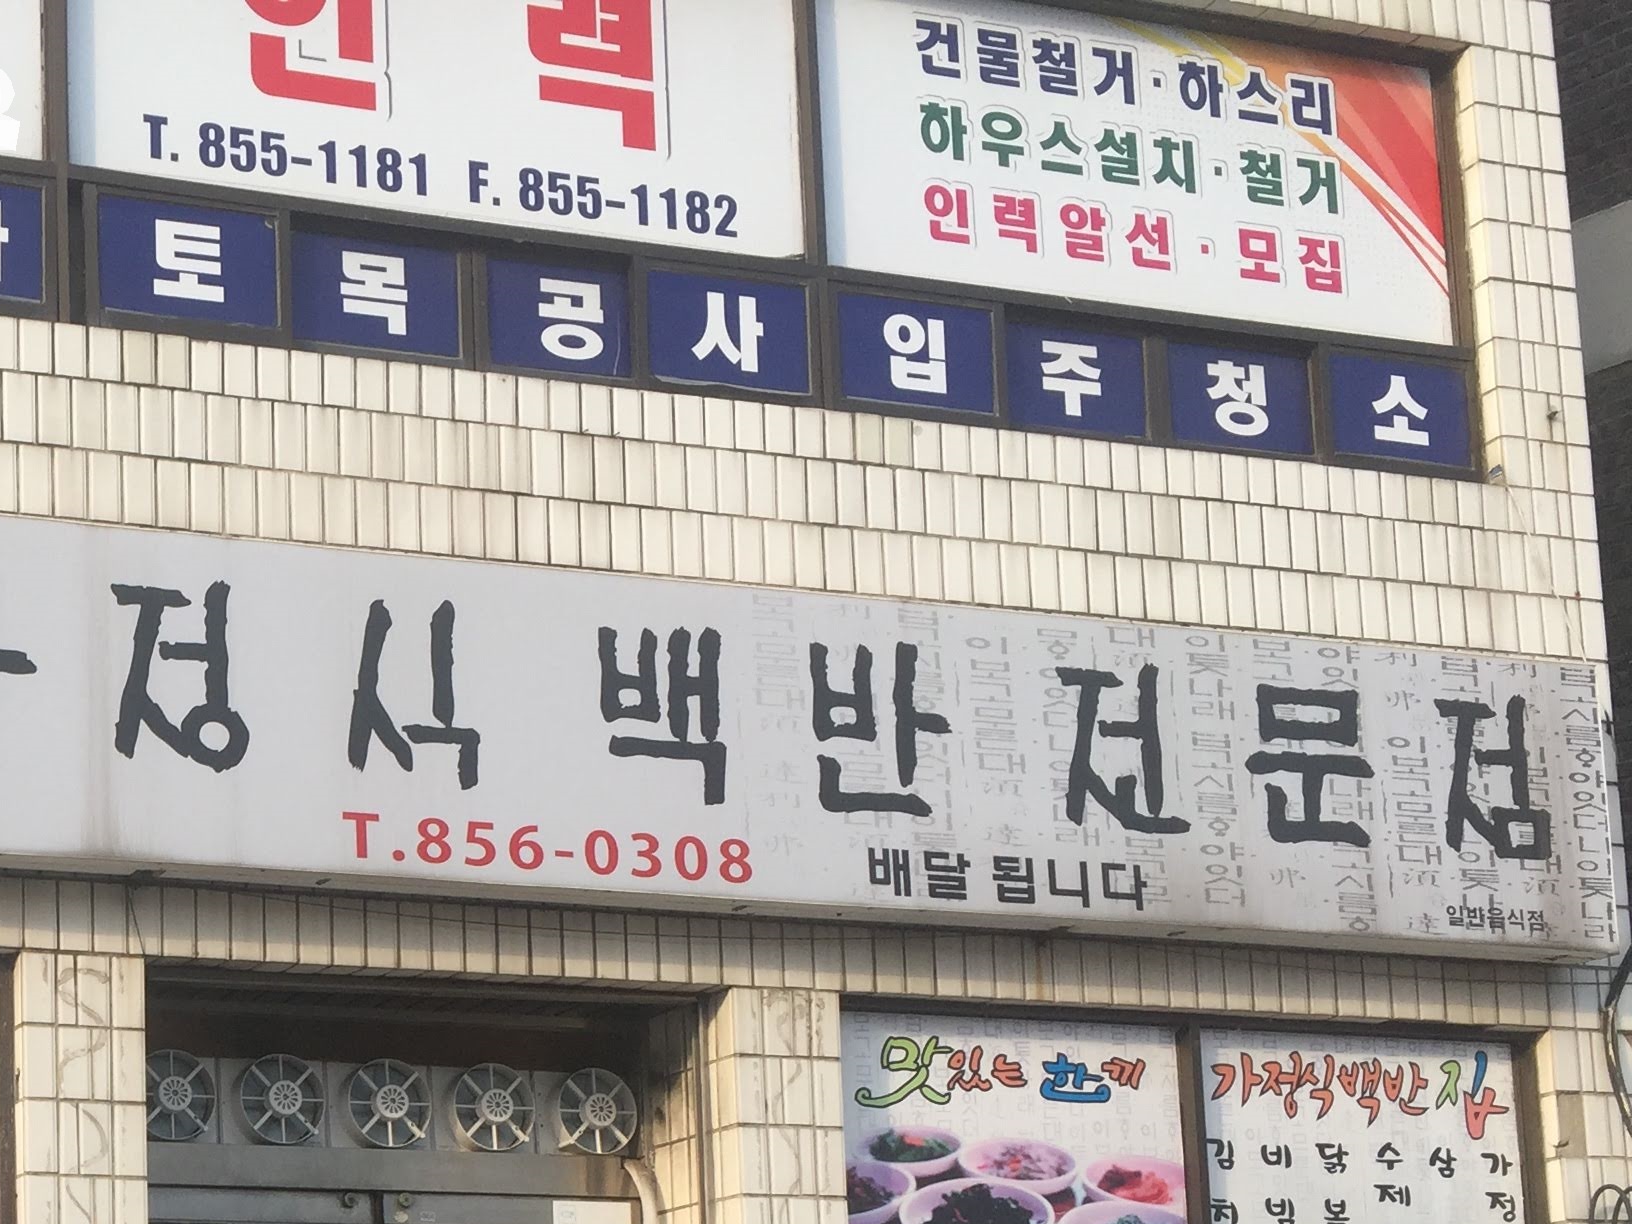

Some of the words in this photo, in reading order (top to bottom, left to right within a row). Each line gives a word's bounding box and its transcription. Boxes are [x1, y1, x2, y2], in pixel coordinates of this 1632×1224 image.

[198, 122, 429, 198] 855-1181
[518, 167, 740, 240] 855-1182
[1445, 904, 1546, 932] 일반음식점
[856, 1035, 1028, 1109] 맛있는
[1040, 1051, 1148, 1104] 한끼
